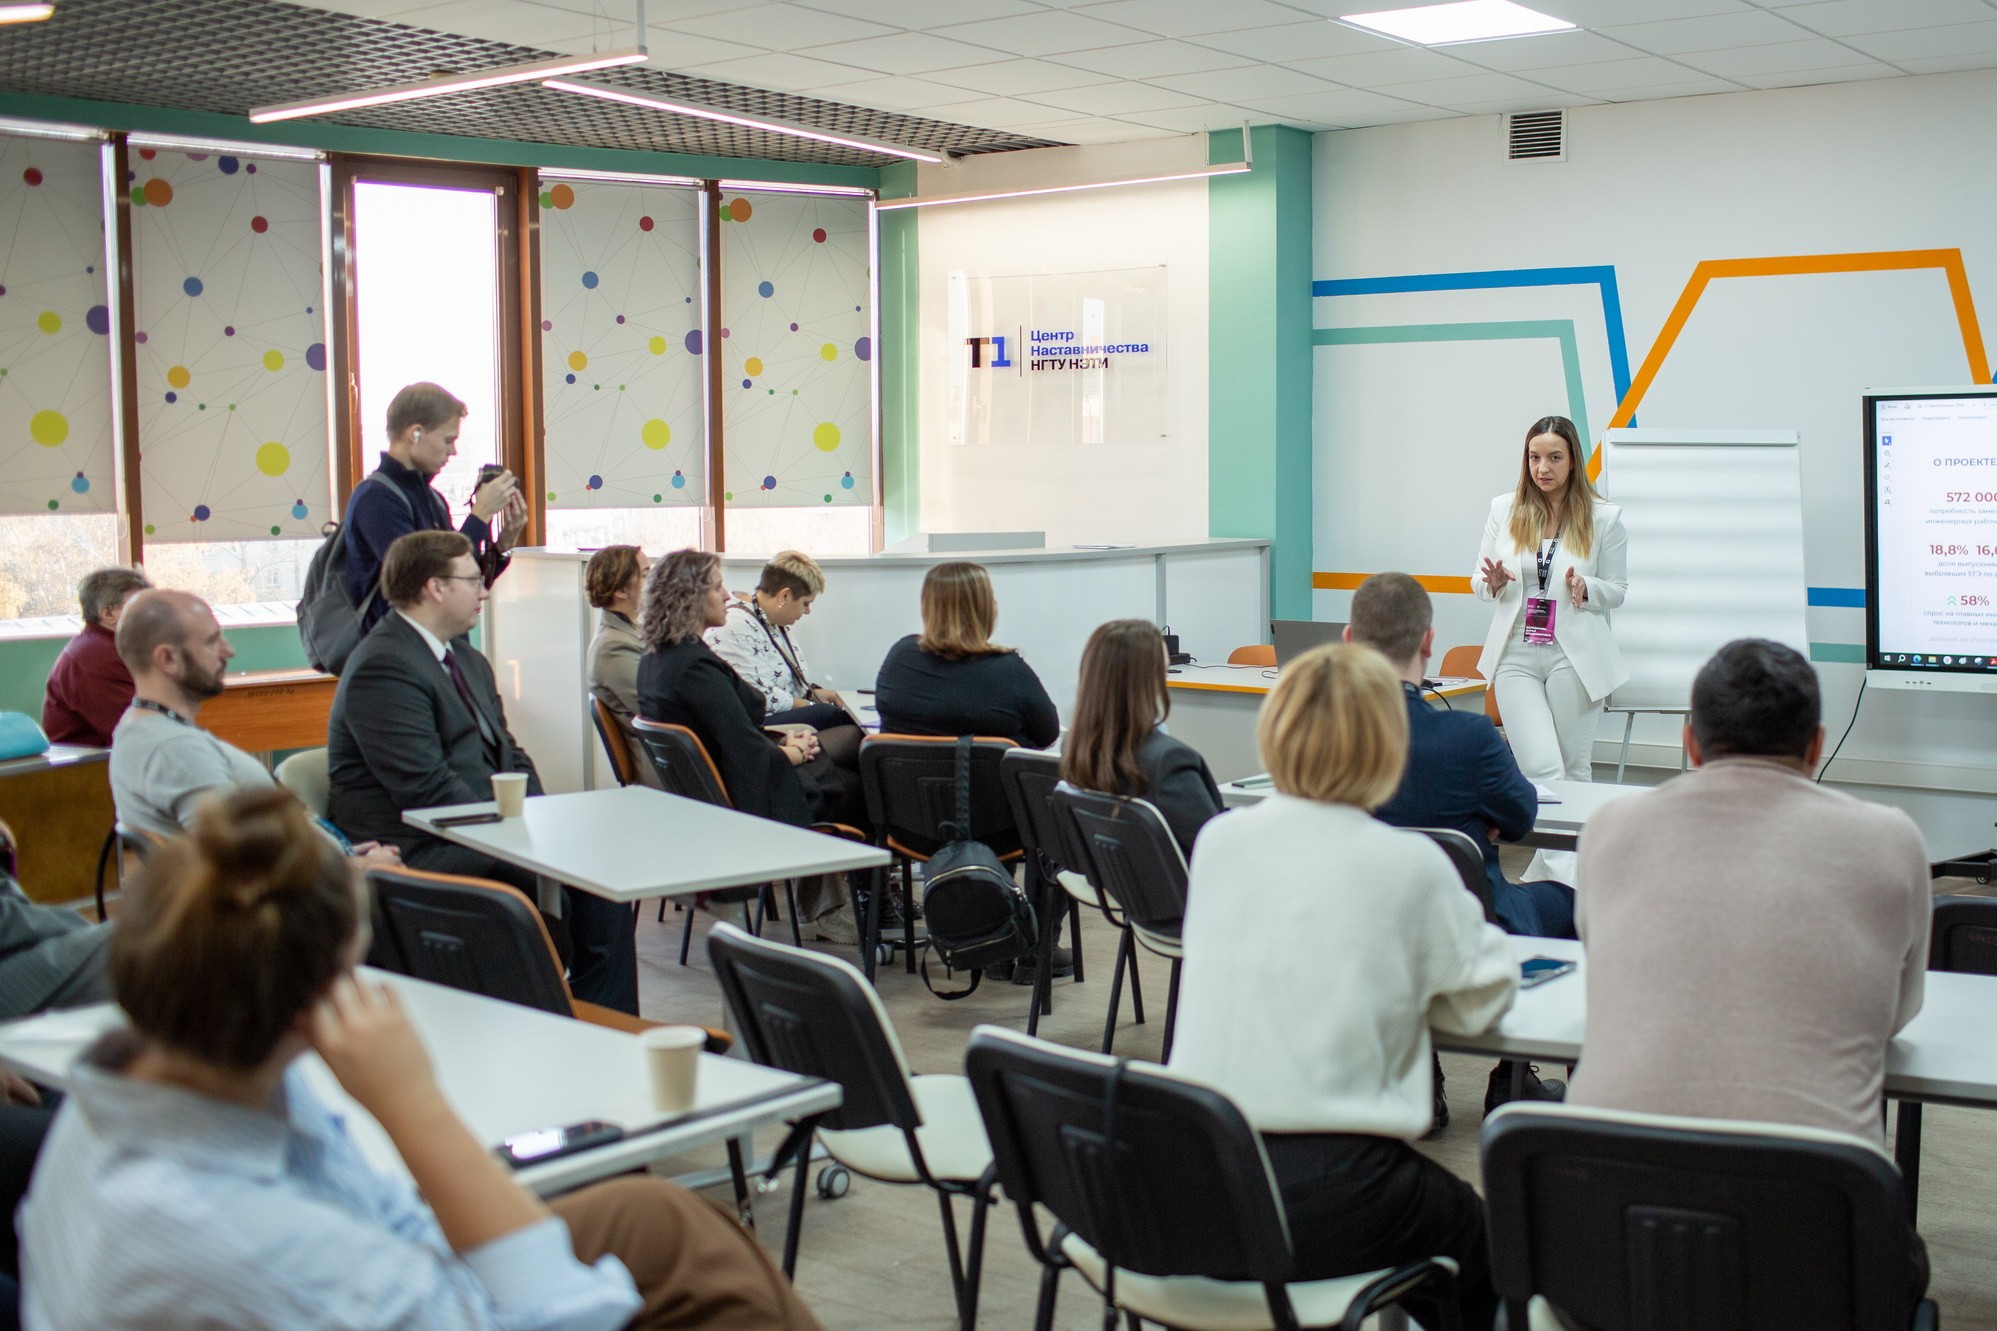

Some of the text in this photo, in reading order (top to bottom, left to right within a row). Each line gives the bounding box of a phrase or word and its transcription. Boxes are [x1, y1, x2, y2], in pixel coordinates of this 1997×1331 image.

[1030, 330, 1075, 343] Центр
[1030, 342, 1149, 356] Наставничества
[1030, 357, 1109, 371] НГТУ НЭТИ
[1933, 457, 1997, 467] О ПРОЕКТЕ
[1946, 491, 1971, 503] 572
[1929, 507, 1976, 515] потребность
[1929, 544, 1969, 557] 18,8%
[1924, 569, 1967, 577] выбравших
[1960, 595, 1990, 606] 58%
